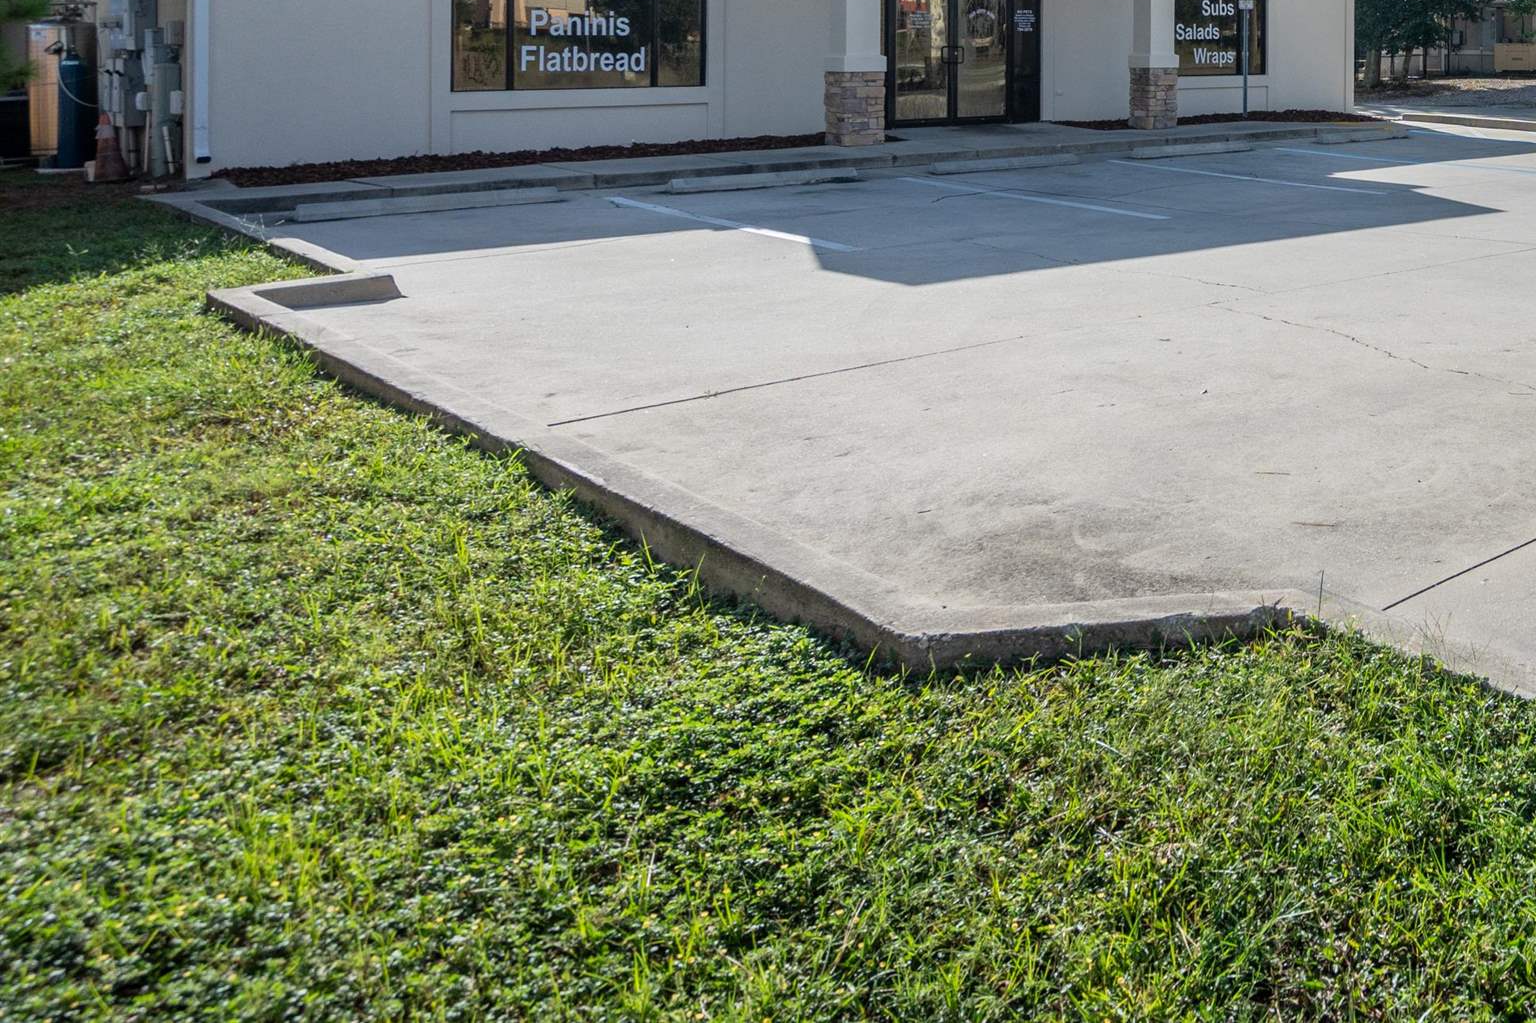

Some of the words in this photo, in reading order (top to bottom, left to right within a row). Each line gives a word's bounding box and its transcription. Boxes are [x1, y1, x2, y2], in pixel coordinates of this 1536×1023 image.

[1201, 0, 1236, 17] Subs
[530, 9, 631, 36] Paninis
[1175, 23, 1221, 41] Salads
[520, 45, 647, 72] Flatbread
[1192, 47, 1235, 68] Wraps
